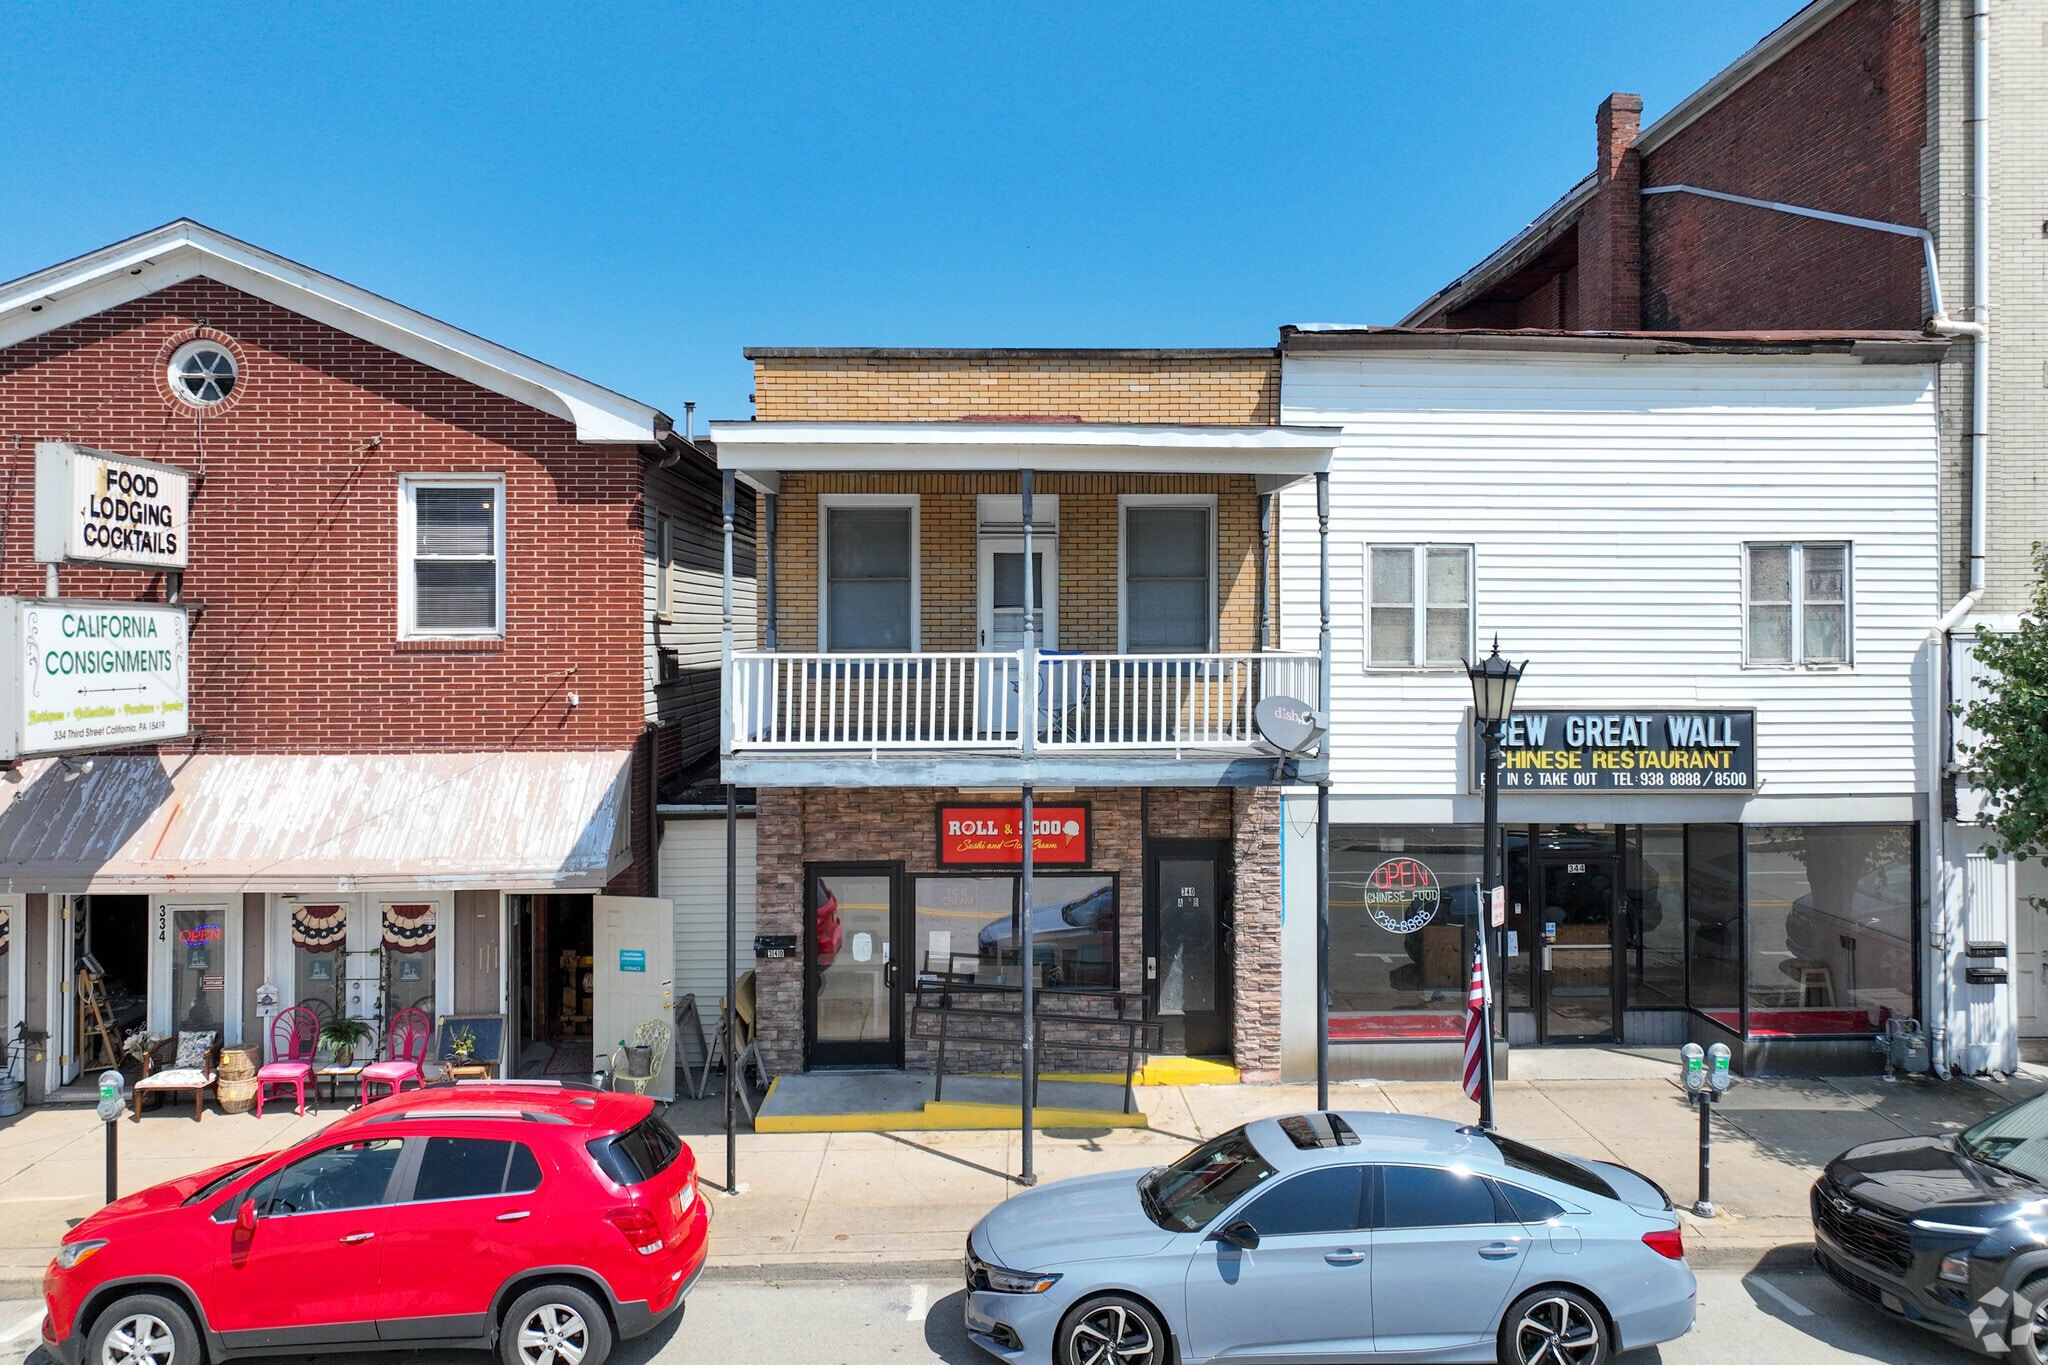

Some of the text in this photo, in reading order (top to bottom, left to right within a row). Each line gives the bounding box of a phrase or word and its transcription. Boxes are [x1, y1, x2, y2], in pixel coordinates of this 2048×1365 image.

[107, 469, 158, 498] FOOD
[91, 495, 172, 527] LODGING
[84, 523, 177, 554] COCKTAILS
[62, 614, 157, 638] CALIFORNIA
[45, 650, 172, 675] CONSIGNMENTS
[1274, 707, 1299, 722] dish
[53, 730, 67, 740] 334
[68, 729, 85, 739] Third
[85, 726, 105, 737] Street
[138, 722, 147, 731] PA
[148, 720, 166, 731] 15419
[1565, 714, 1654, 748] GREAT
[1666, 714, 1741, 748] WALL
[1592, 750, 1733, 769] RESTAURANT
[1507, 773, 1519, 785] IN
[1524, 772, 1534, 786] &
[1538, 773, 1568, 785] TAKE
[1573, 772, 1598, 786] OUT
[948, 820, 999, 836] ROLL
[1004, 823, 1014, 835] &
[957, 839, 987, 852] Sushi
[986, 840, 1005, 850] and
[1374, 861, 1429, 890] OPEN
[1568, 864, 1586, 873] 344
[947, 887, 968, 897] ICE
[1366, 889, 1438, 904] CHINESE FOOD
[942, 897, 975, 906] CREAM
[1374, 909, 1431, 933] 938-8888
[179, 928, 223, 942] OPEN
[767, 949, 785, 958] 340
